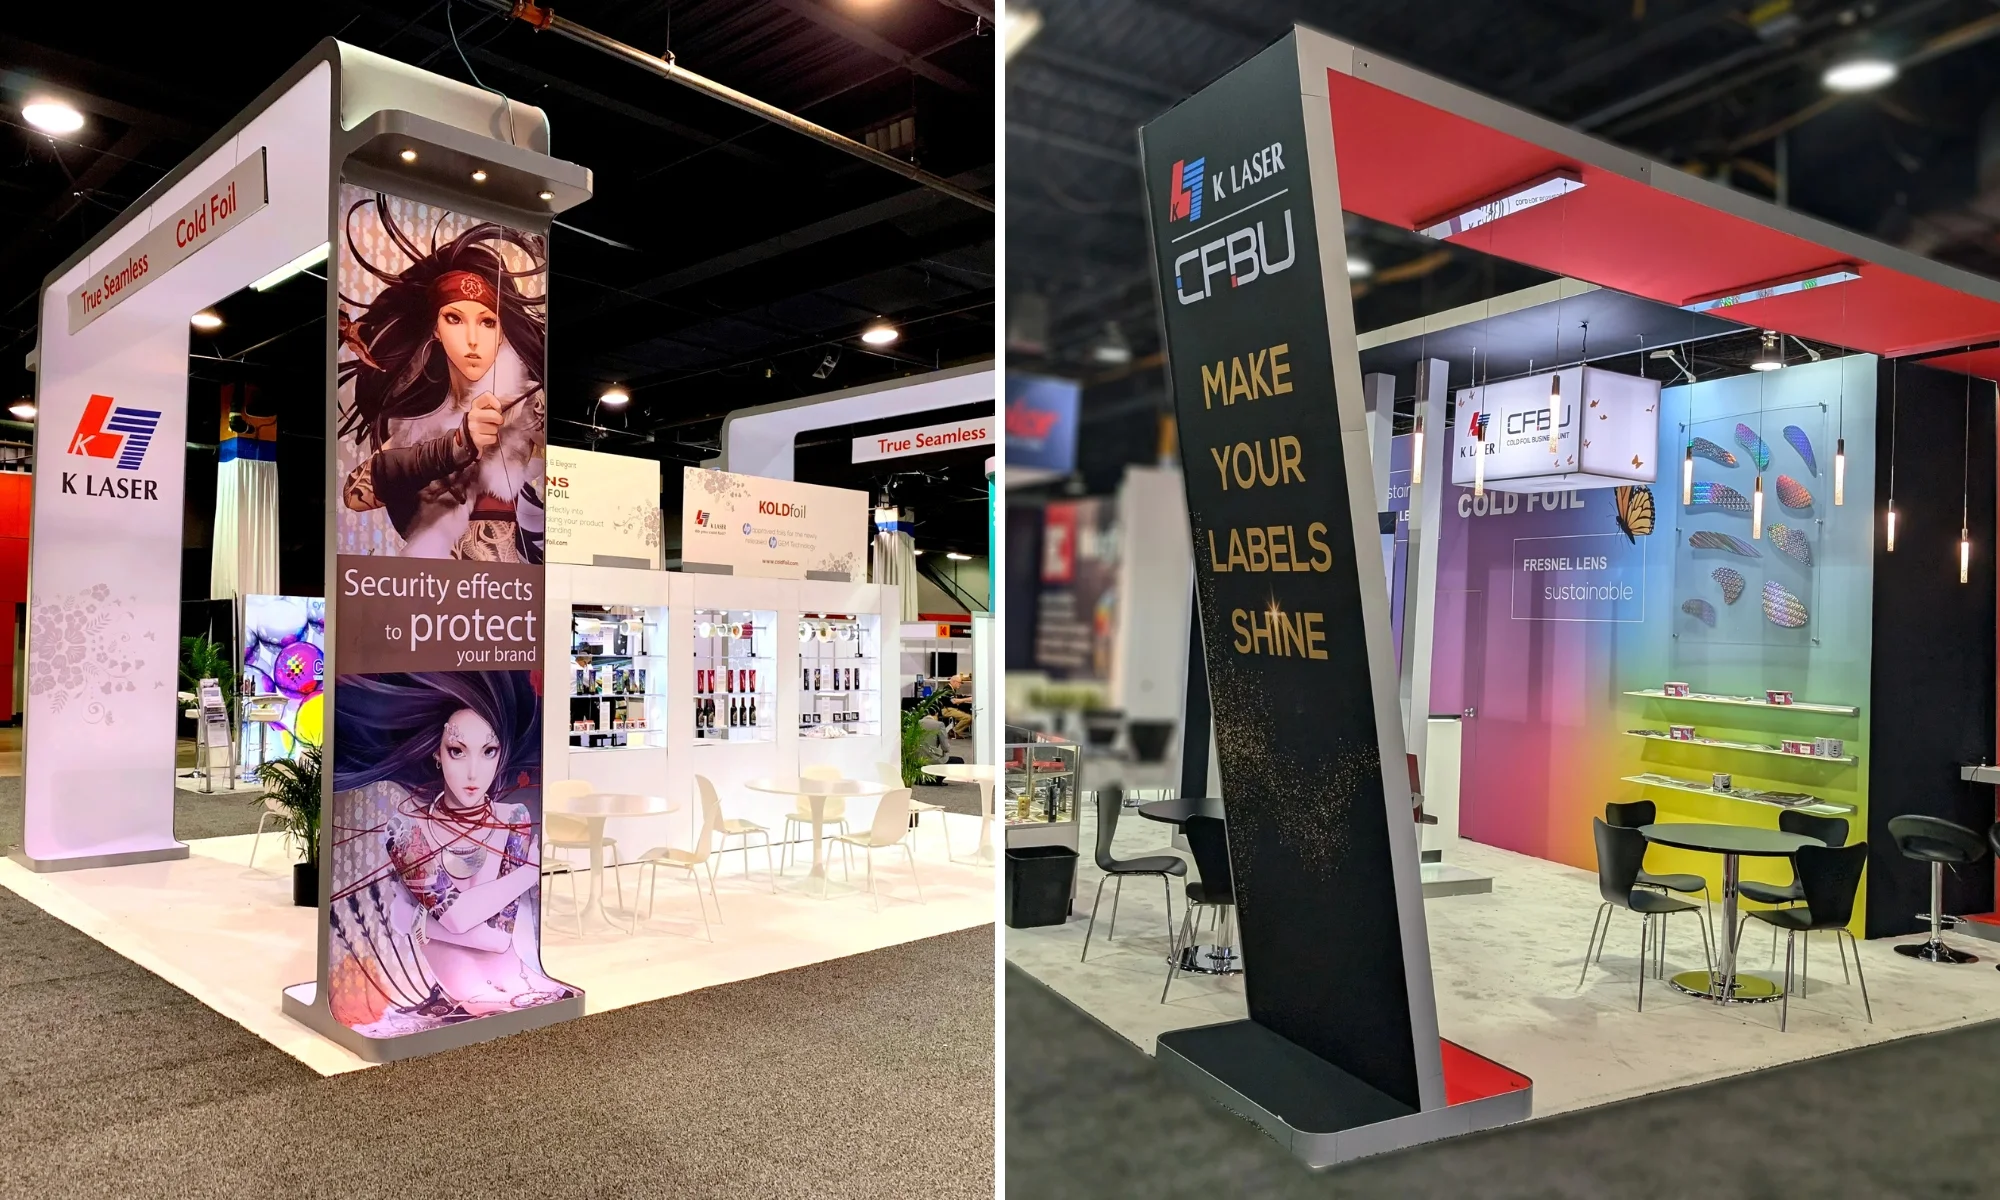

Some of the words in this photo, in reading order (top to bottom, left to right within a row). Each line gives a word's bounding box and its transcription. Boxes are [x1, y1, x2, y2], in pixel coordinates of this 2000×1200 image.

[1212, 171, 1226, 202] K
[1230, 142, 1286, 194] LASER
[176, 203, 206, 248] Cold
[211, 181, 236, 226] Foil
[1174, 209, 1296, 305] CFBU
[81, 288, 102, 314] True
[104, 254, 148, 300] Seamless
[1201, 343, 1294, 410] MAKE
[878, 439, 911, 453] True
[916, 428, 986, 448] Seamless
[1460, 446, 1466, 458] K
[1532, 434, 1551, 443] BUSINE
[1210, 435, 1306, 491] YOUR
[62, 471, 78, 495] K
[86, 474, 159, 501] LASER
[545, 475, 570, 488] NS
[548, 488, 570, 499] FOIL
[759, 500, 807, 519] KOLDfoil
[1458, 489, 1519, 518] COLD
[1527, 489, 1585, 513] FOIL
[1208, 521, 1333, 573] LABELS
[1523, 557, 1573, 572] FRESNEL
[1576, 556, 1608, 570] LENS
[344, 568, 450, 606] Security
[456, 573, 533, 601] effects
[1544, 581, 1634, 601] sustainable
[385, 624, 402, 640] to
[410, 608, 537, 652] protect
[1231, 607, 1329, 661] SHINE
[456, 649, 491, 667] your
[494, 646, 536, 662] brand
